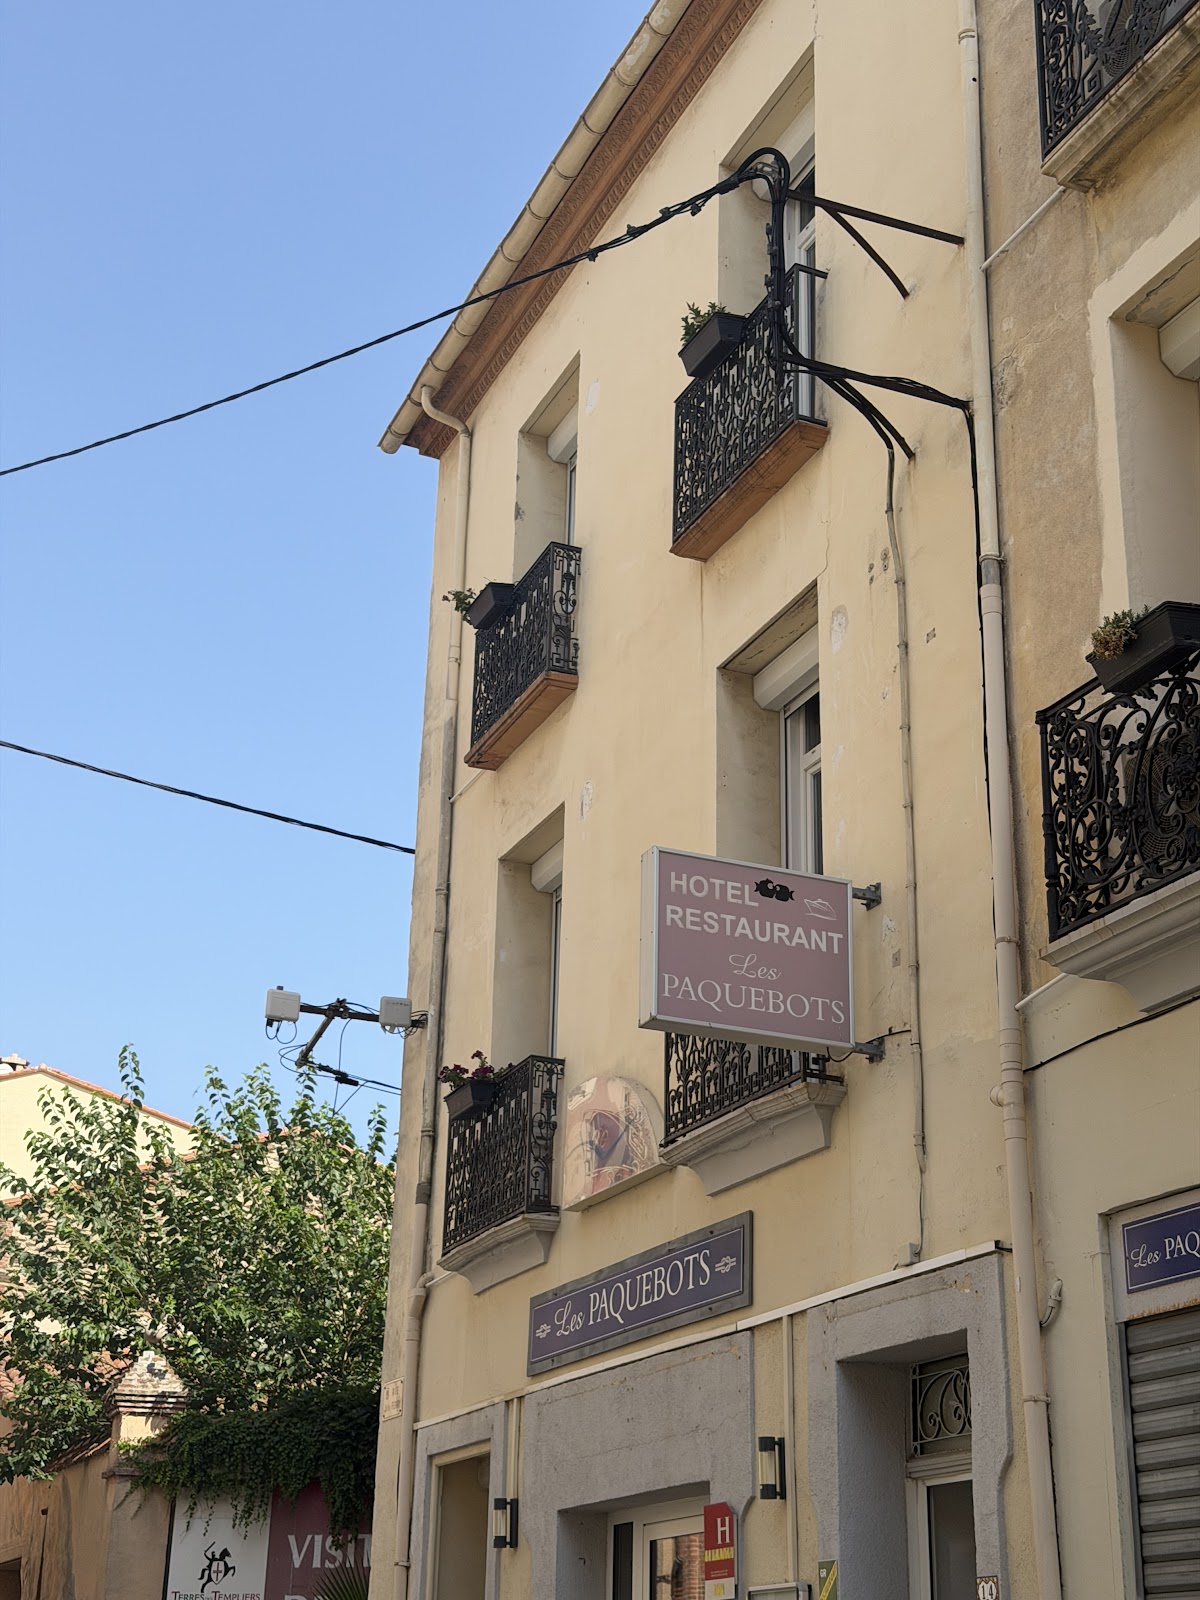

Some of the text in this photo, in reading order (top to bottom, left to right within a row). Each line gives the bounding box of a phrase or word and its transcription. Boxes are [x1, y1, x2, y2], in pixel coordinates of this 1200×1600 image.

[670, 871, 759, 907] HOTEL
[666, 904, 844, 954] RESTAURANT
[728, 953, 782, 981] Les
[662, 973, 845, 1024] PAQUEBOTS
[1130, 1243, 1161, 1268] Les
[554, 1249, 711, 1336] Les PAQUEBOTS
[716, 1516, 731, 1544] H
[981, 1583, 994, 1600] 14
